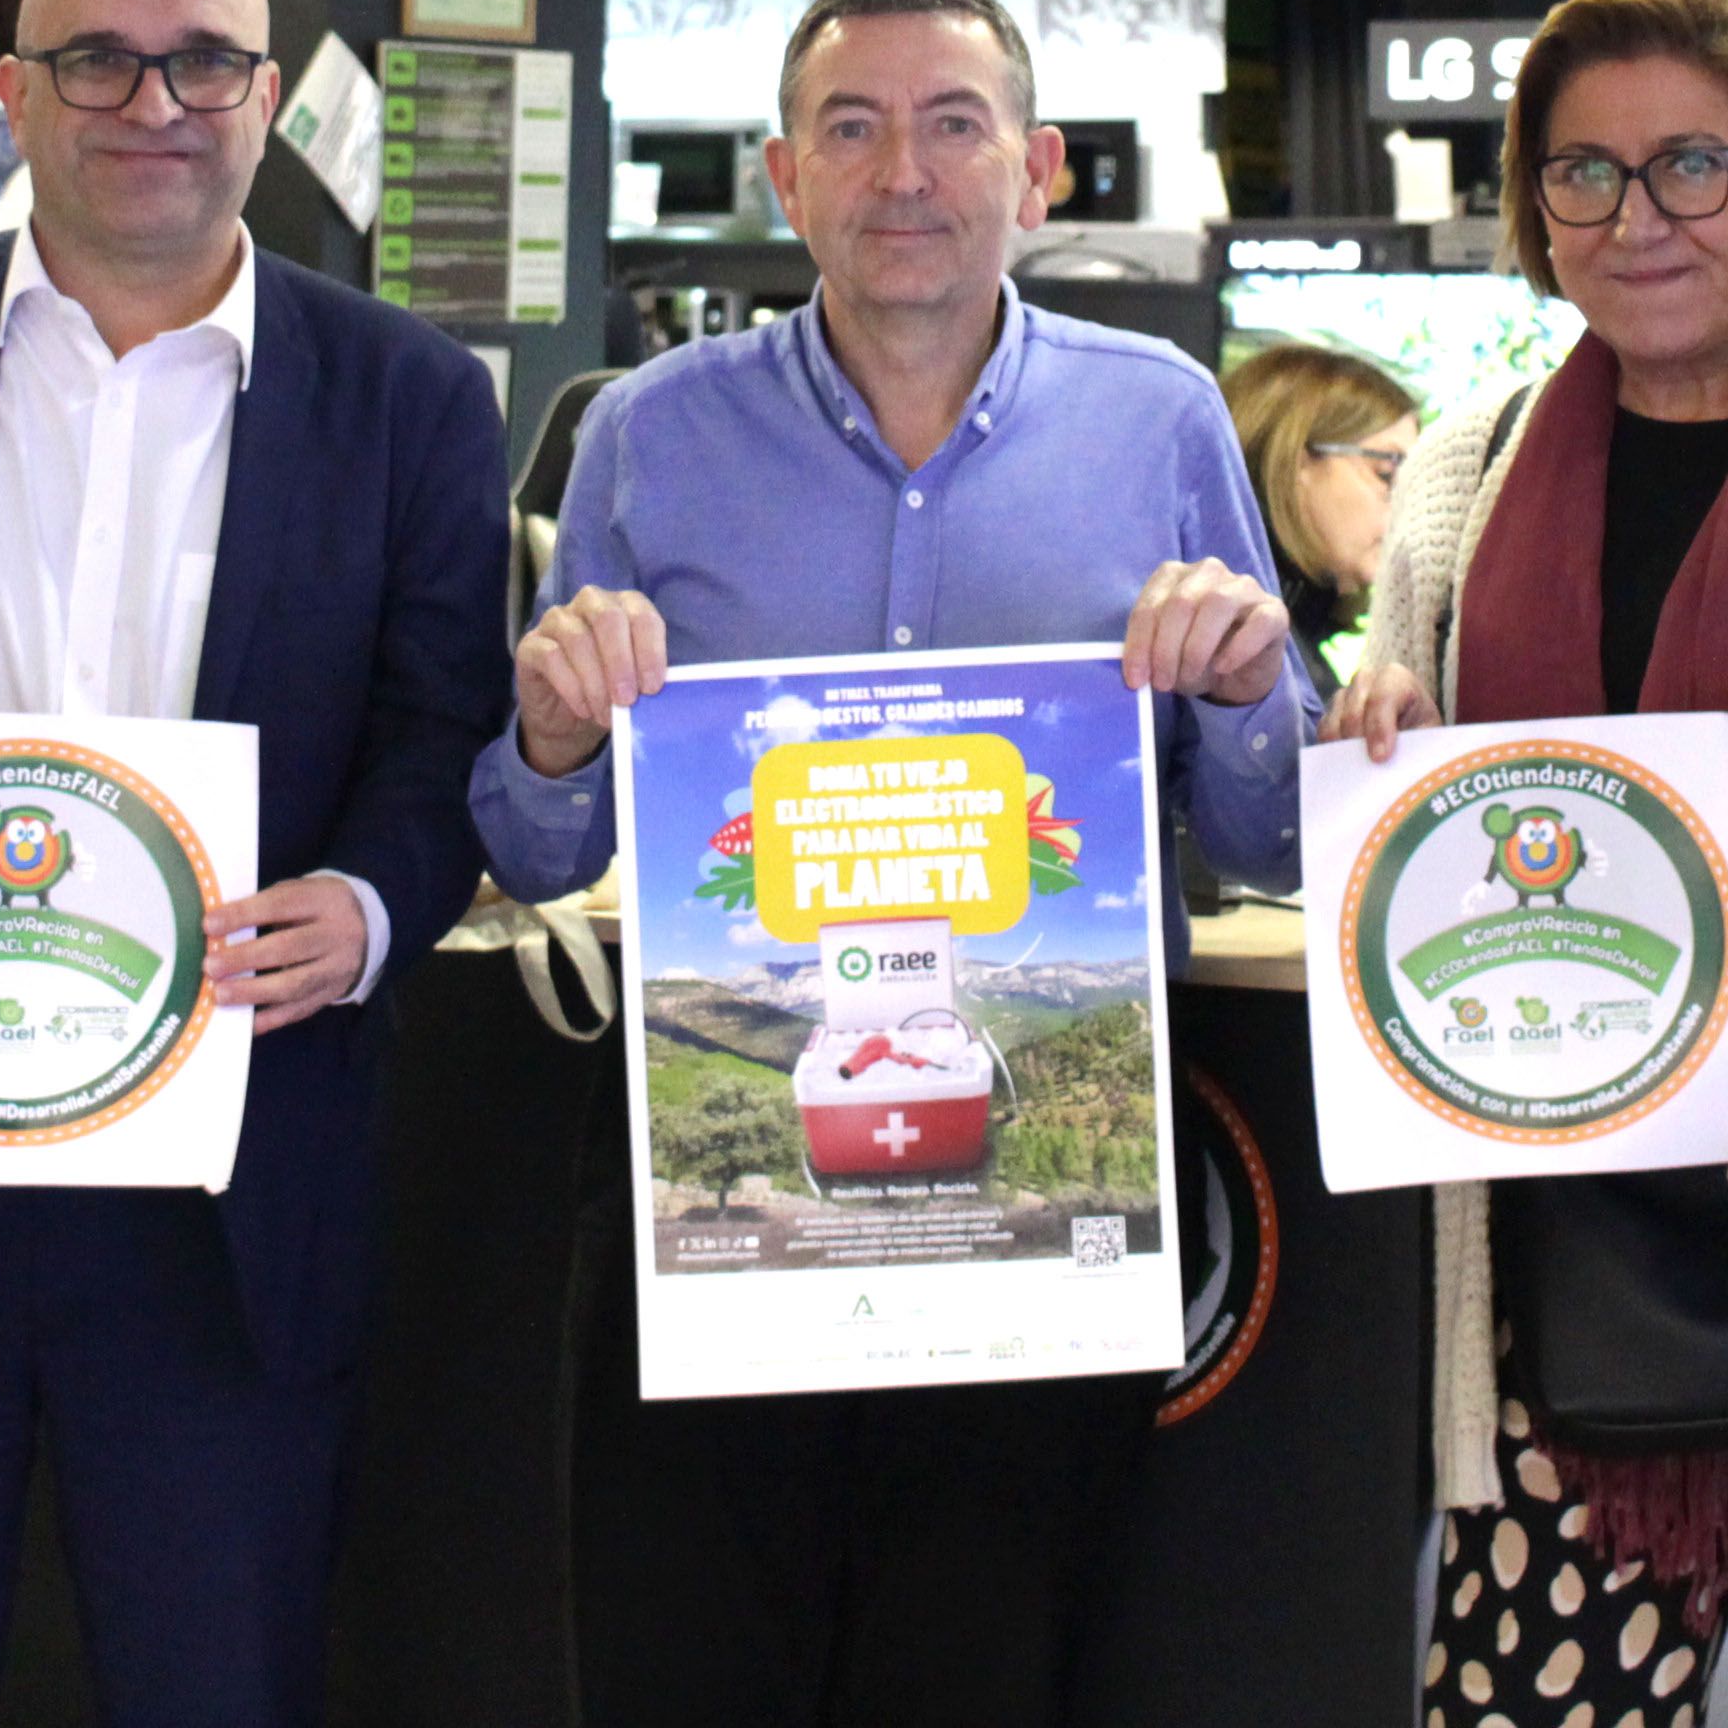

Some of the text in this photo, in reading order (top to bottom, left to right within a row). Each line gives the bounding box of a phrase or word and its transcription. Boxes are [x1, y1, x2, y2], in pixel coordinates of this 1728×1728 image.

[1386, 38, 1474, 101] LG
[1430, 763, 1629, 816] #ECOtiendasFAEL
[793, 853, 991, 910] PLANETA
[879, 951, 937, 972] raee
